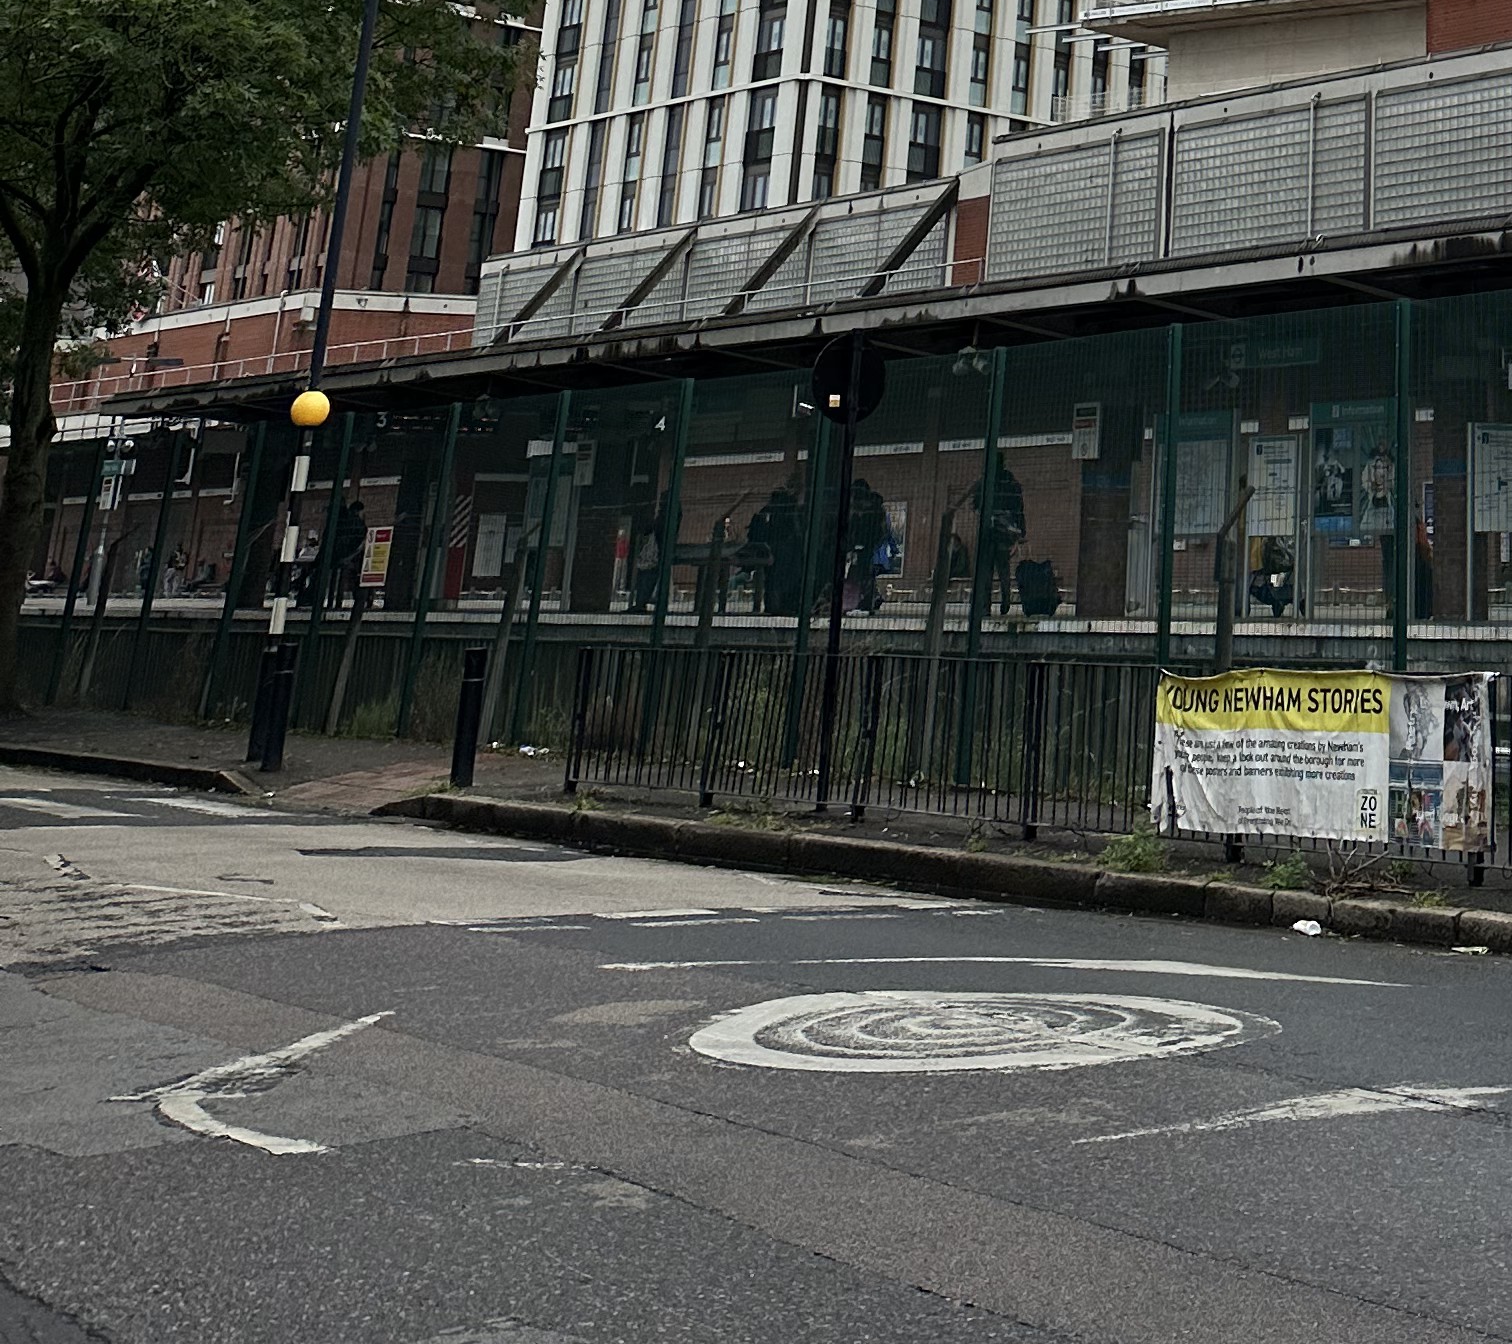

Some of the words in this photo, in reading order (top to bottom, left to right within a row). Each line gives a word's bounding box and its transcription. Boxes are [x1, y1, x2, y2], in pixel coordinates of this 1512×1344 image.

[376, 411, 389, 428] 3
[654, 415, 667, 432] 4
[1223, 686, 1301, 713] NEWHAM
[1307, 688, 1384, 714] STORIES
[1245, 739, 1257, 748] the
[1255, 753, 1268, 762] out
[1347, 757, 1365, 767] more
[1360, 795, 1377, 811] ZO
[1360, 812, 1377, 828] NE
